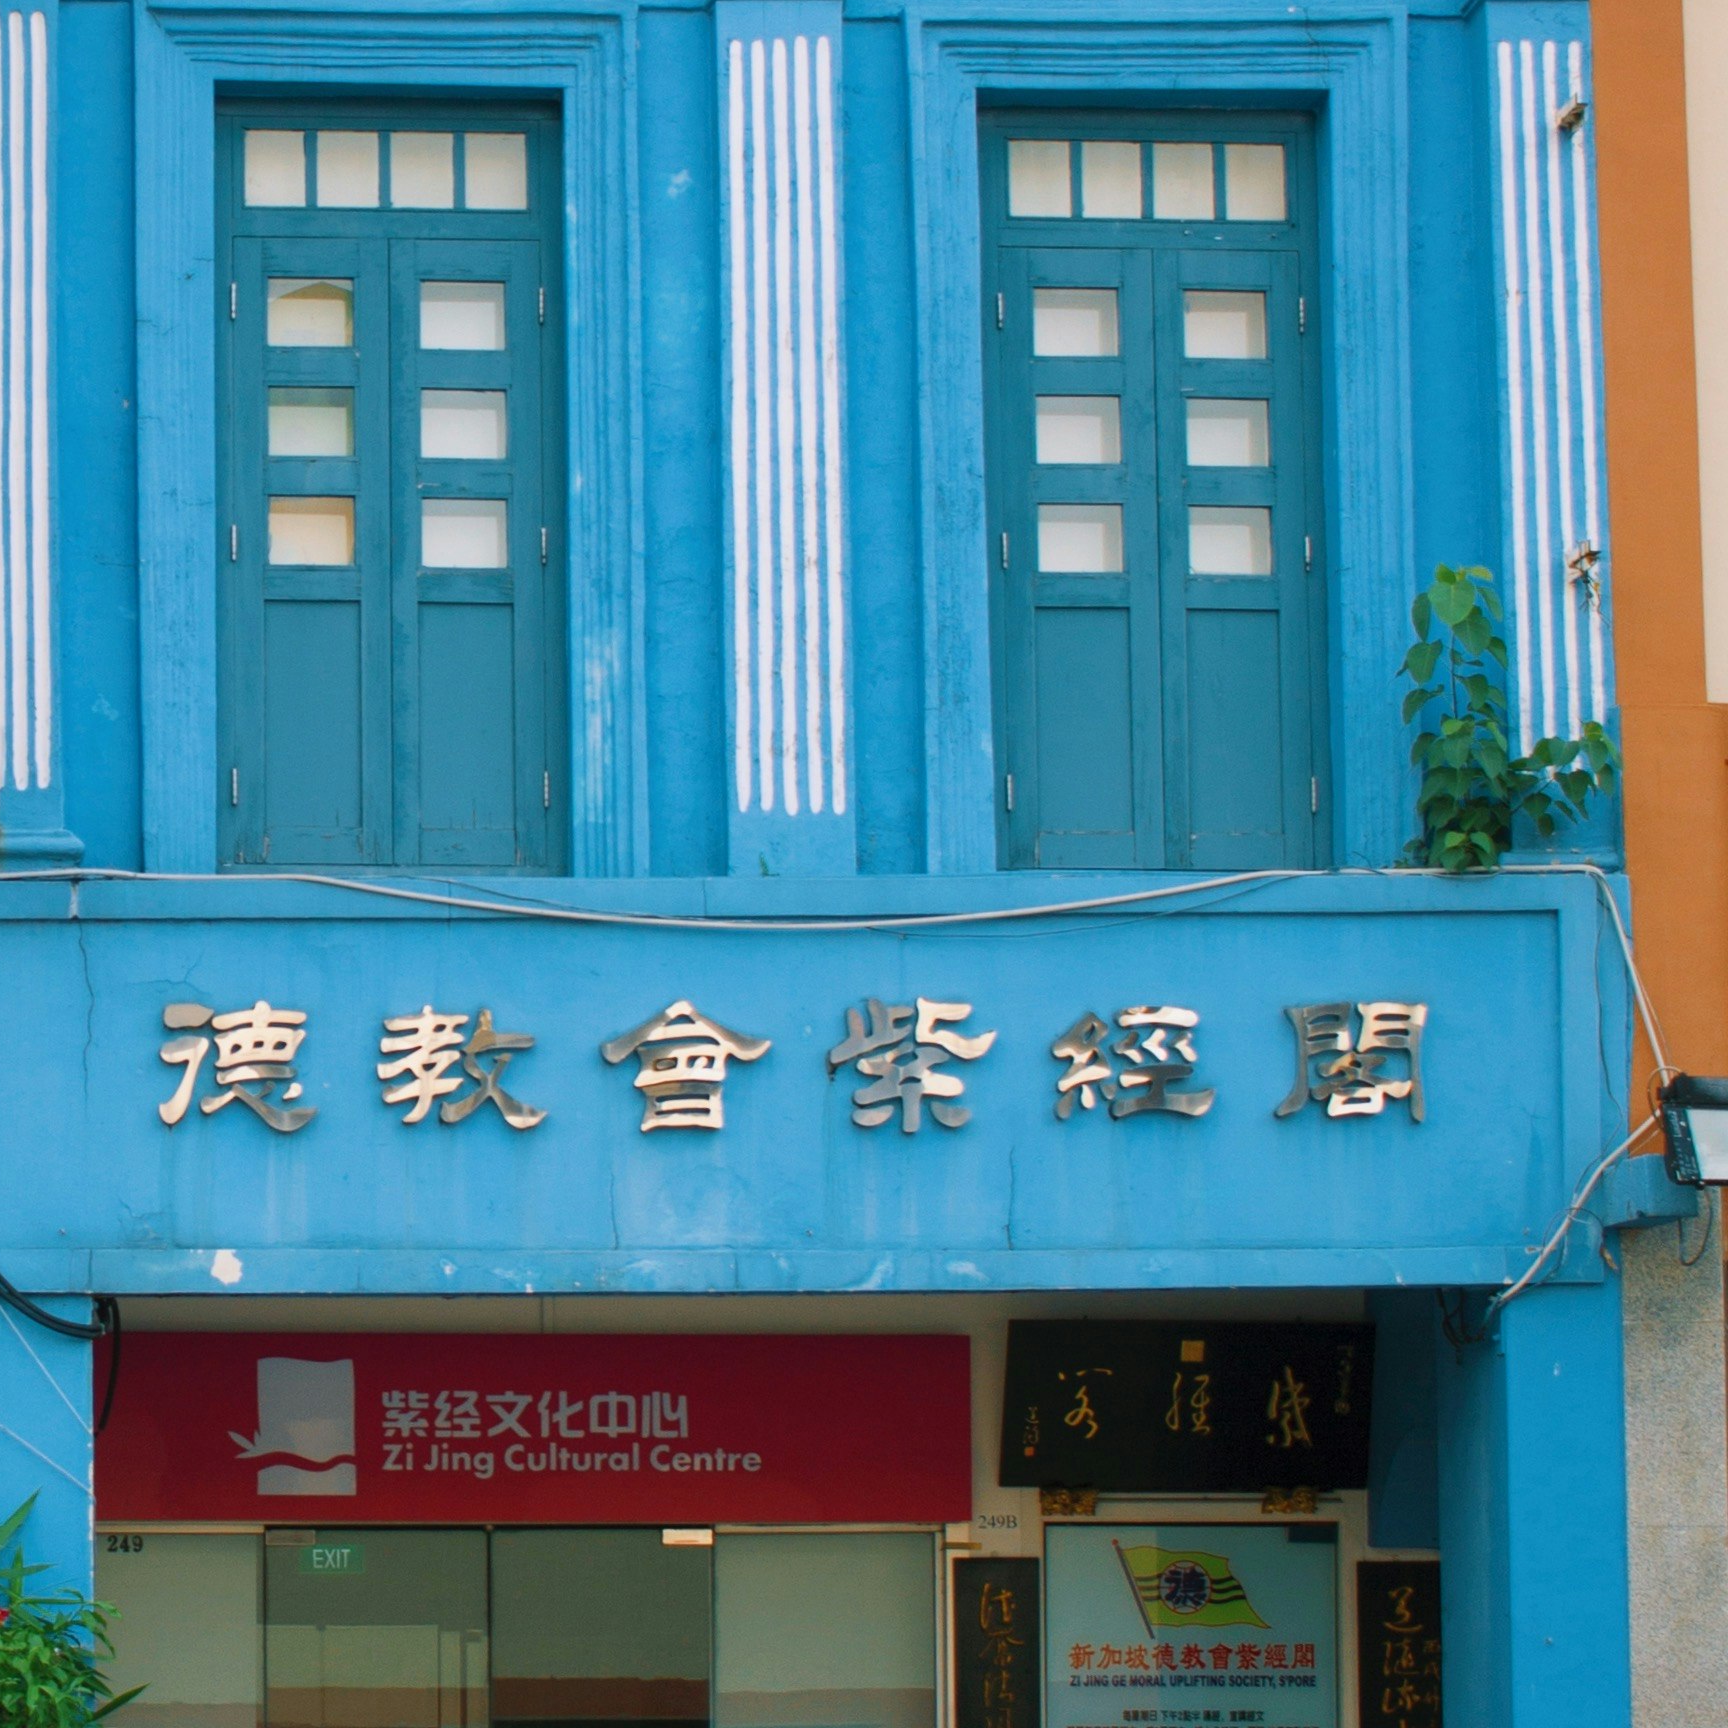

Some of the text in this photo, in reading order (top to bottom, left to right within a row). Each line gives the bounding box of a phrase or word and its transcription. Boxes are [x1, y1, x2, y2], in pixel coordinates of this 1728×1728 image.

[160, 998, 1432, 1135] 德教會紫經閣
[381, 1390, 689, 1438] 紫经文化中心
[381, 1442, 762, 1479] Zi Jing Cultural Centre
[977, 1515, 1017, 1529] 249B
[107, 1534, 144, 1553] 249
[312, 1548, 351, 1569] EXIT
[1068, 1642, 1316, 1671] 新加坡德教會紫經閣
[1070, 1675, 1080, 1687] ZI
[1083, 1675, 1109, 1687] JING
[1112, 1675, 1127, 1687] GE
[1129, 1675, 1166, 1687] MORAL
[1170, 1675, 1225, 1687] UPLIFTING
[1229, 1675, 1276, 1689] SOCIETY,
